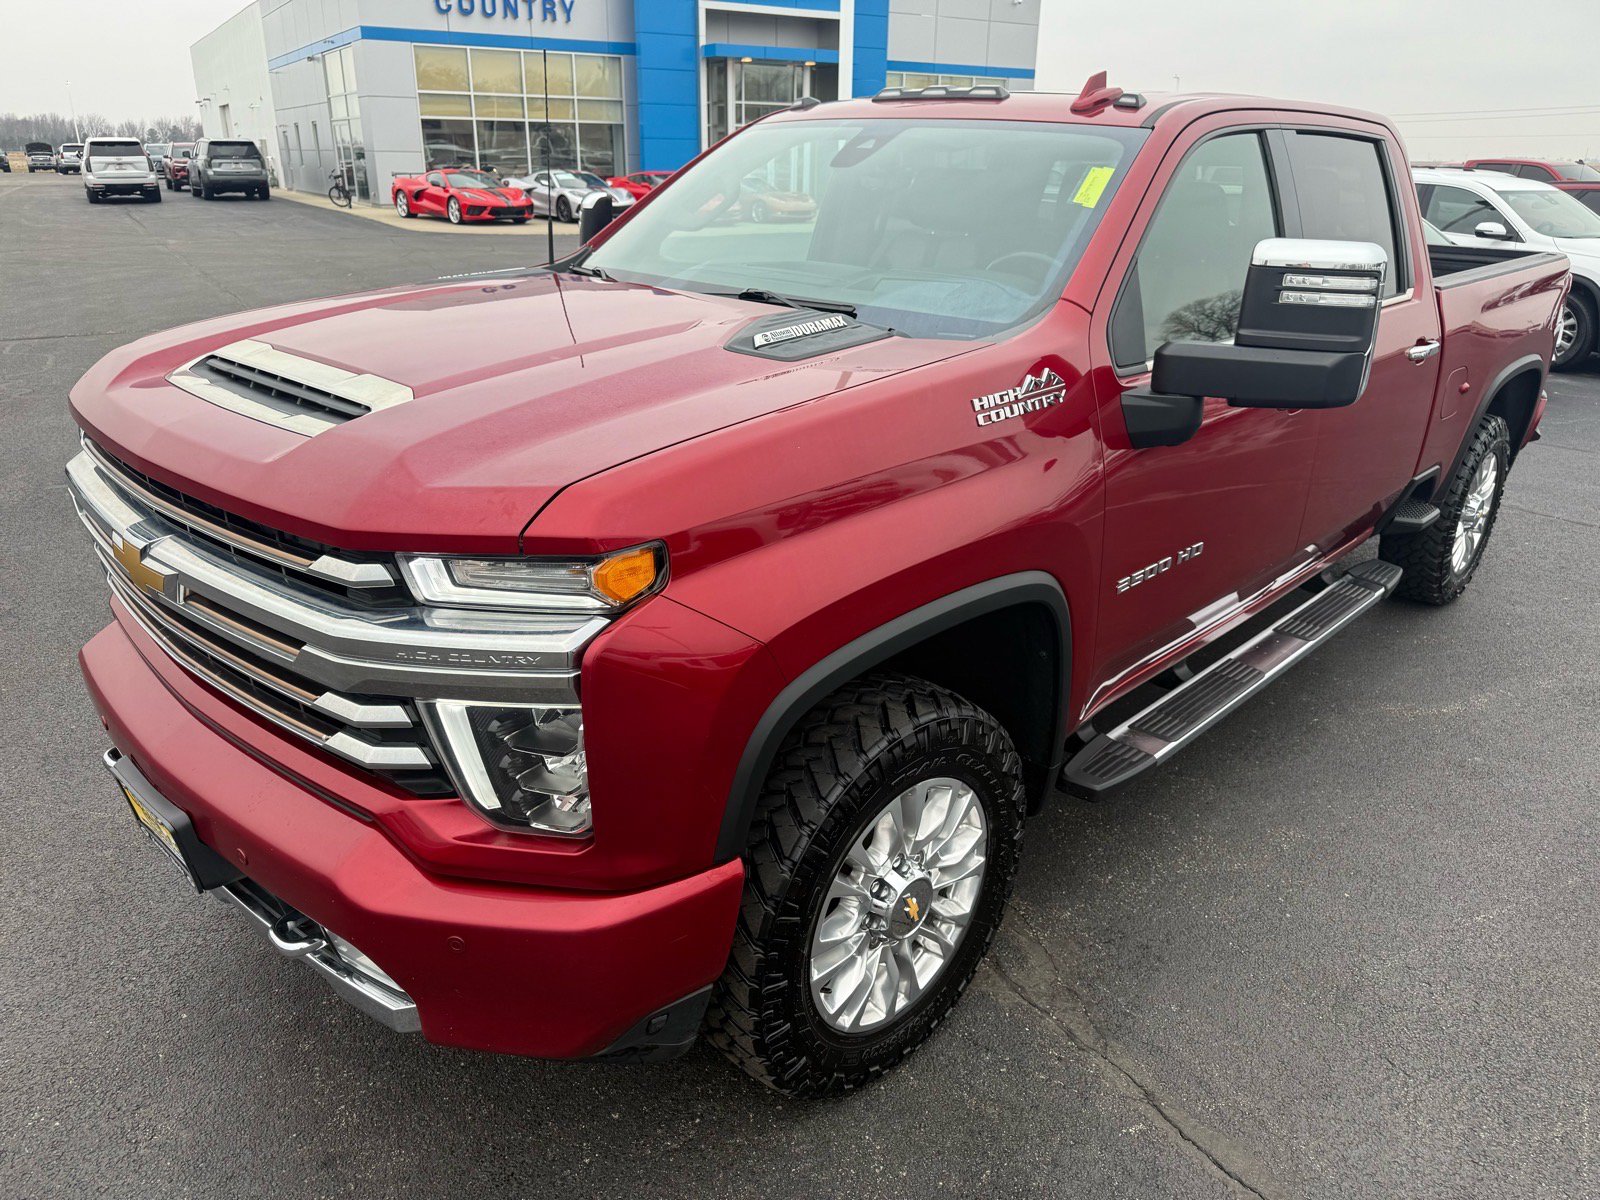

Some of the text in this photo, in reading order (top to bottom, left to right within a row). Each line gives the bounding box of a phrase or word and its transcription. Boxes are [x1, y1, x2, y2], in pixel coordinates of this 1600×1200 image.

[794, 315, 847, 337] DURAMAX
[971, 387, 1022, 412] HIGH
[976, 389, 1066, 427] COUNTRY
[1116, 541, 1204, 595] 2500 HD
[447, 652, 541, 665] COUNTRY
